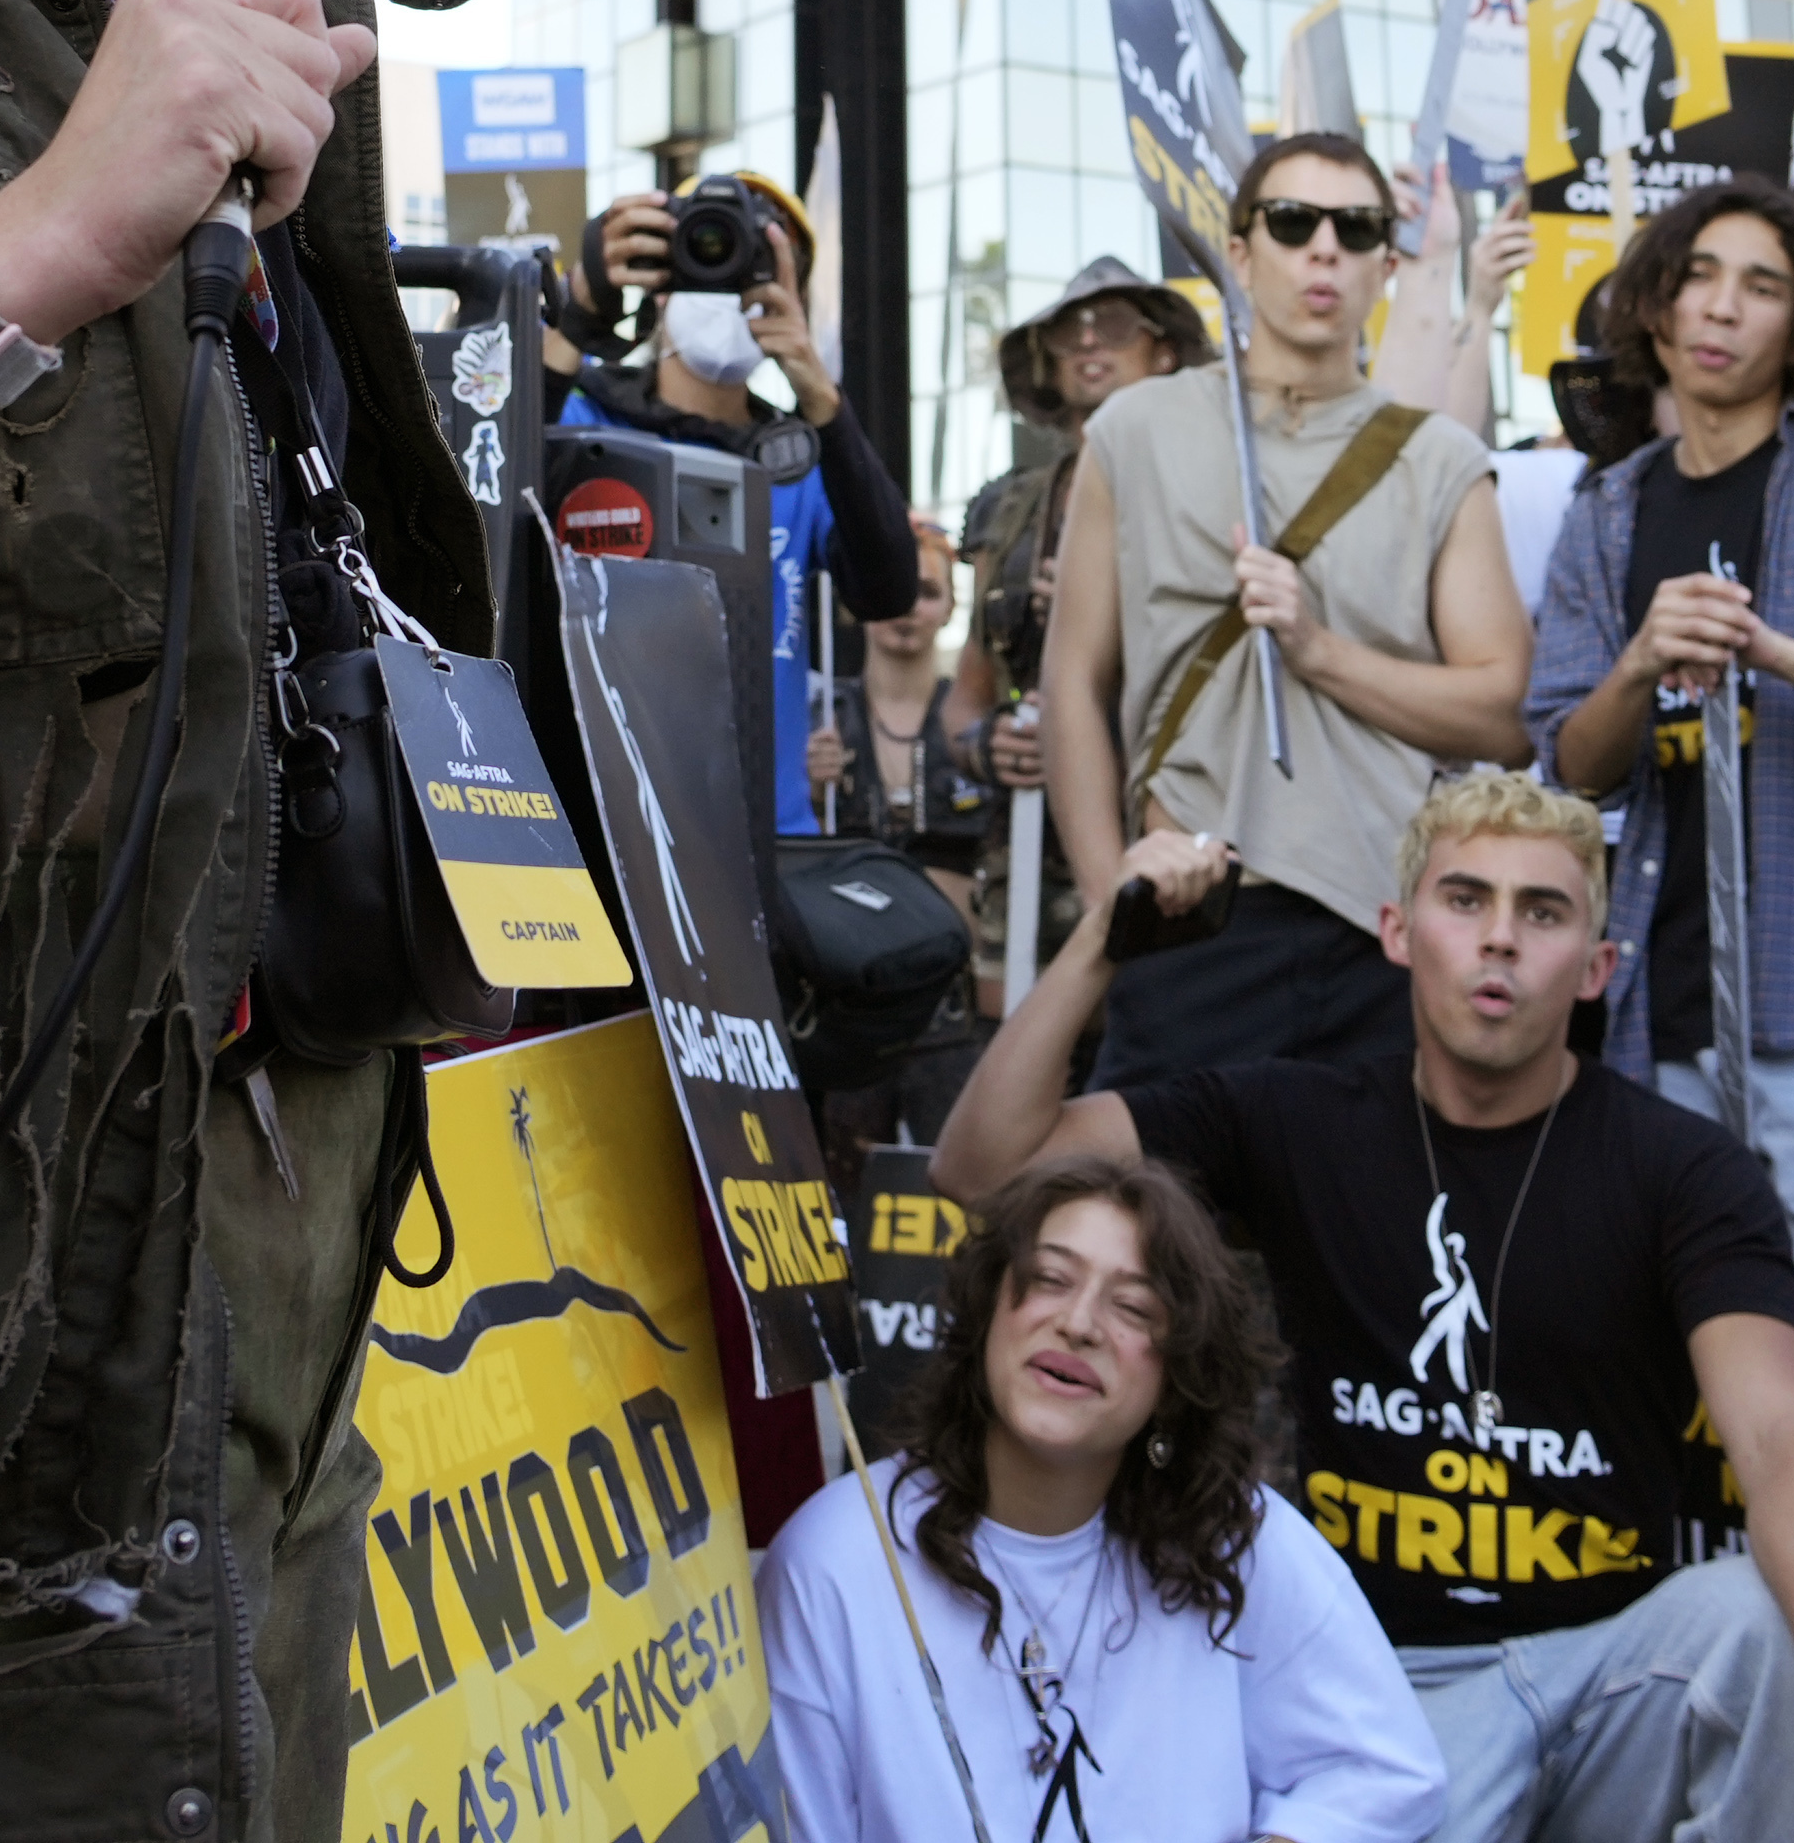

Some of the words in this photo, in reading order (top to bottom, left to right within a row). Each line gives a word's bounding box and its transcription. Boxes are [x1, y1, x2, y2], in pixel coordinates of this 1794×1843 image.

[588, 522, 645, 549] STRIKE
[426, 780, 466, 813] ON
[465, 785, 559, 821] STRIKE!
[500, 919, 582, 943] CAPTAIN
[740, 1109, 775, 1165] ON
[720, 1175, 850, 1293] STRIKE!
[1424, 1448, 1509, 1500] ON
[457, 1745, 519, 1843] AS
[521, 1701, 572, 1819] IT
[575, 1583, 747, 1783] TAKES!!
